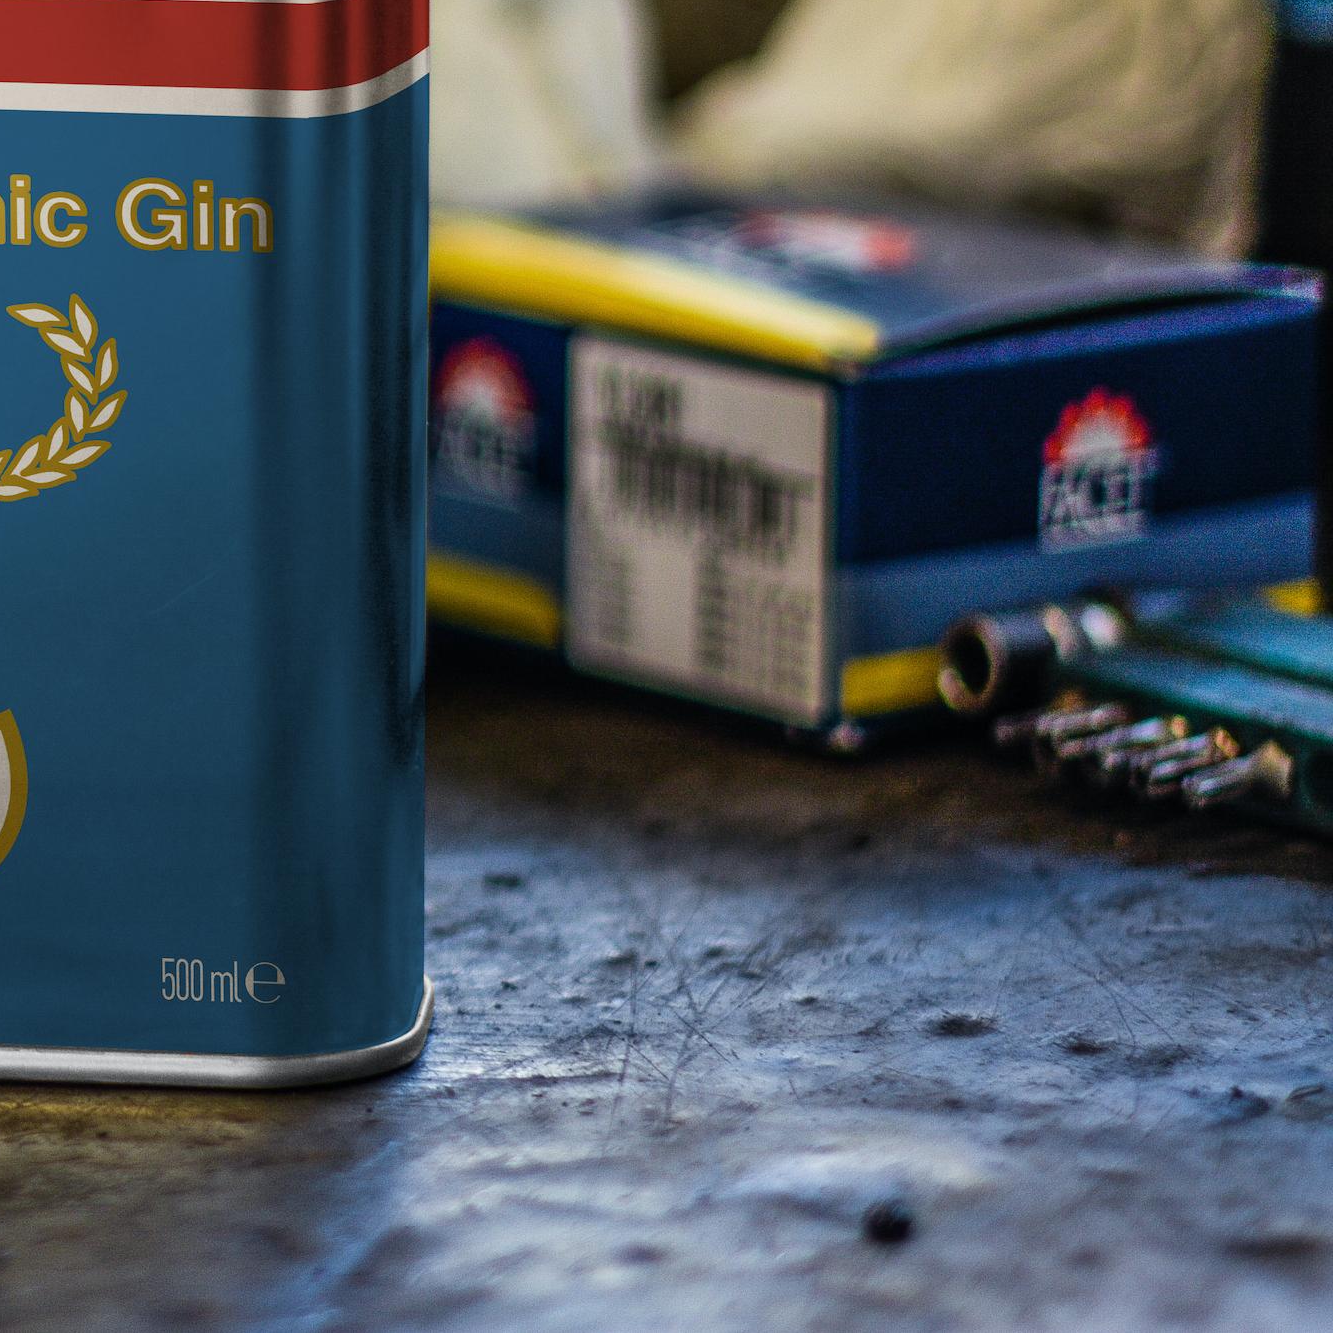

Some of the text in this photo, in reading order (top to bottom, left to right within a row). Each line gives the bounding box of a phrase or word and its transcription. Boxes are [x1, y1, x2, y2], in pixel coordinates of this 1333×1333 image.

[115, 177, 275, 254] Gin
[161, 957, 204, 1002] 500
[210, 960, 243, 1003] ml
